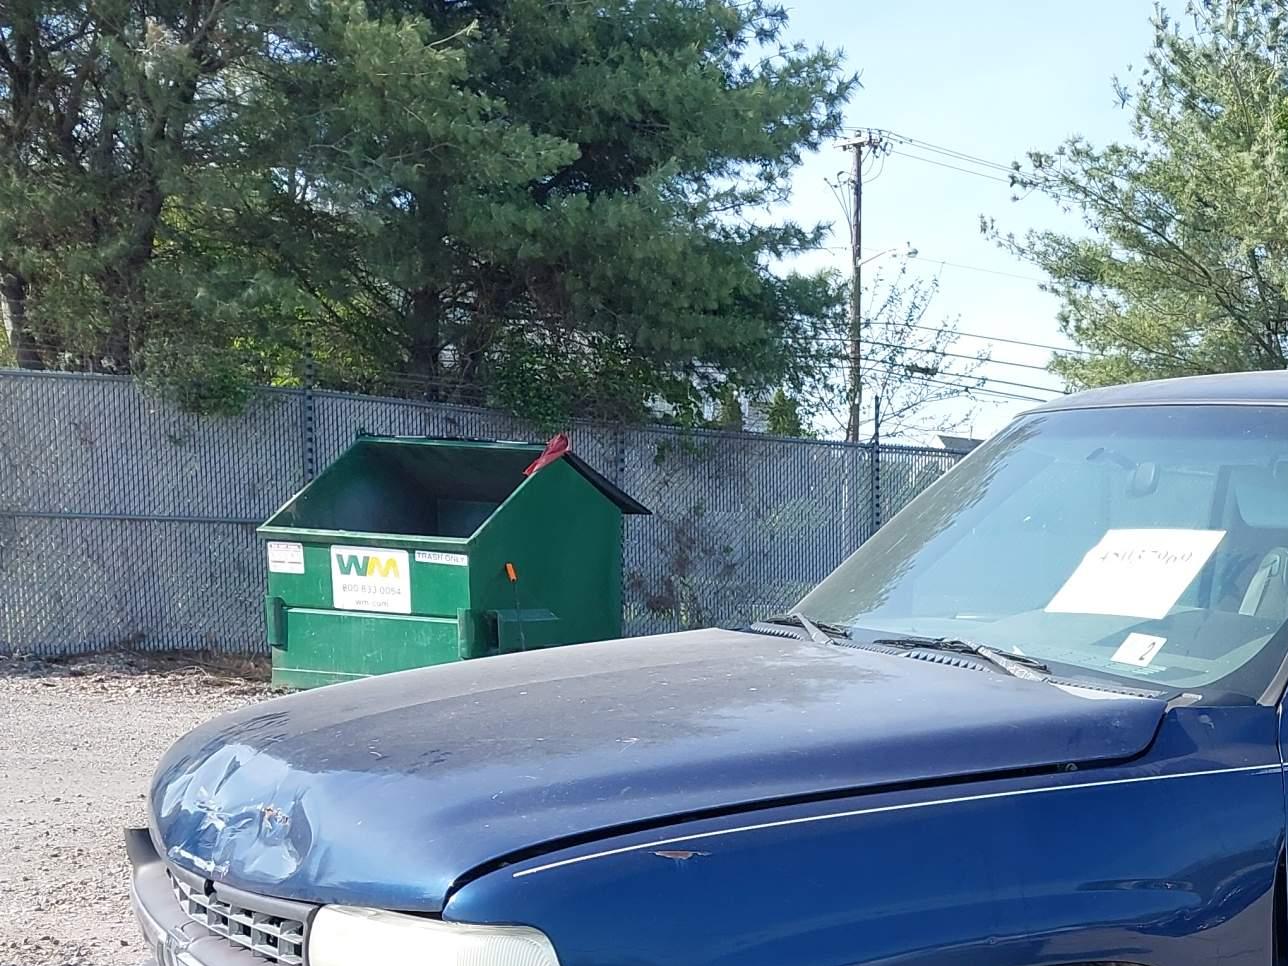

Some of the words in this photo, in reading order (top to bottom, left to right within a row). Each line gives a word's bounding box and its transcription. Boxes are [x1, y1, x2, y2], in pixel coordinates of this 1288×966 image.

[336, 554, 400, 577] WM
[417, 552, 443, 561] TRASH
[445, 555, 465, 563] ONLY
